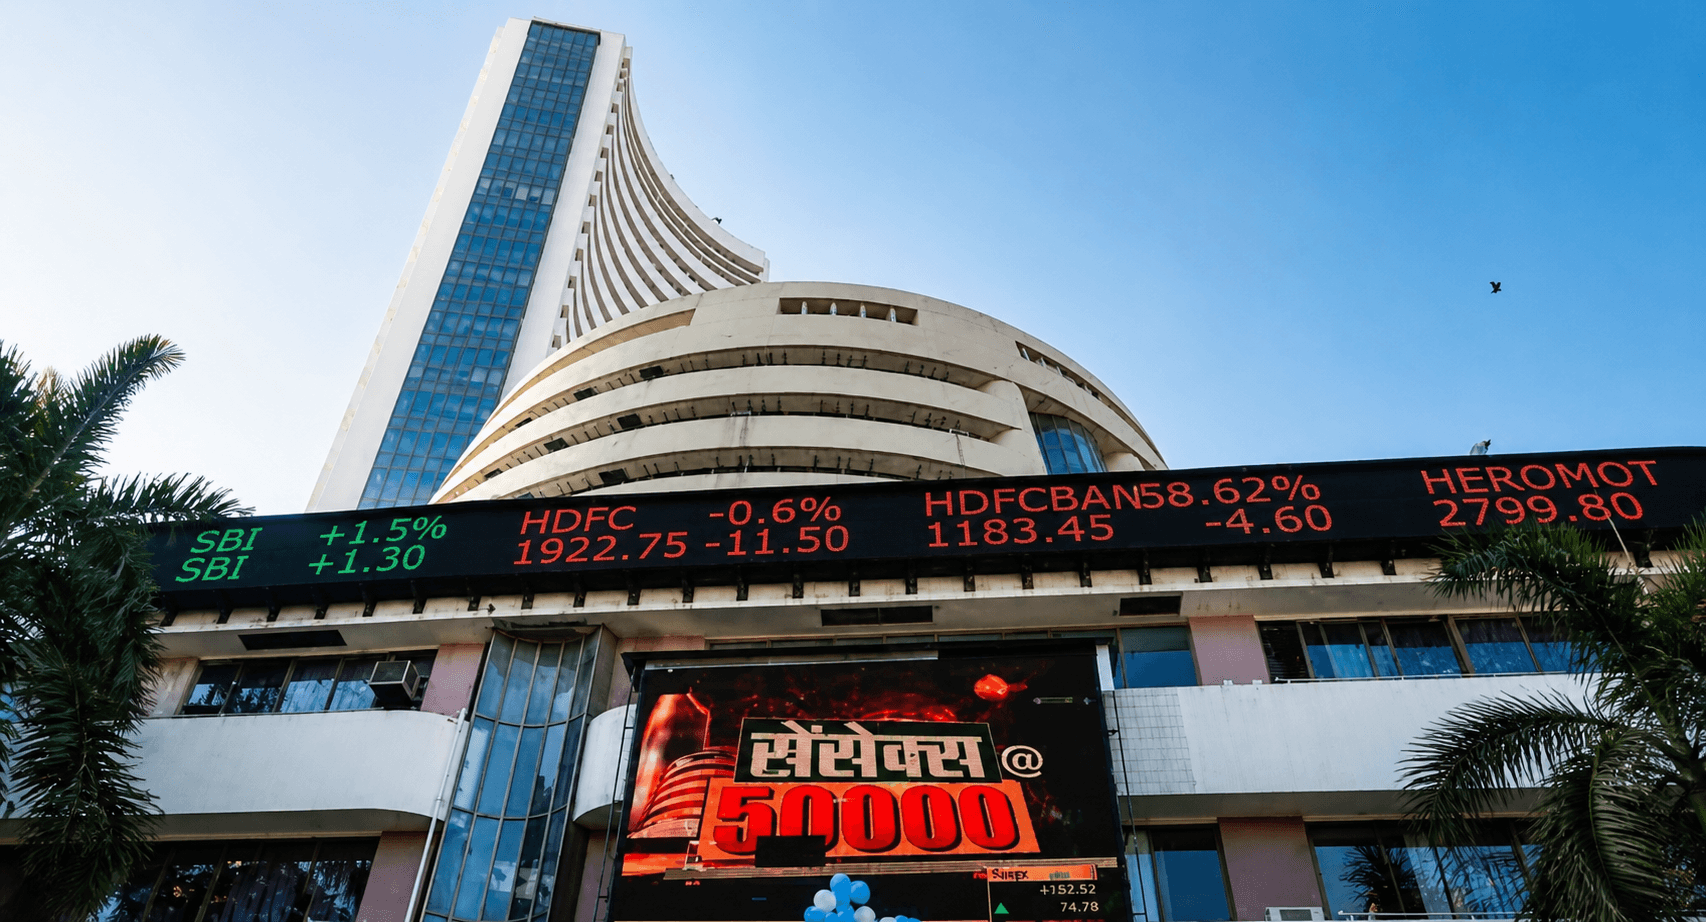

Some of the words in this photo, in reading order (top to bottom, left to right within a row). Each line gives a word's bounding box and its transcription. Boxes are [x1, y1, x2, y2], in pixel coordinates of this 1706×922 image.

[1420, 460, 1658, 494] HEROMOT
[520, 505, 637, 535] HDFC
[709, 496, 842, 526] -0.6%
[928, 514, 1114, 548] 1183.45
[1205, 504, 1332, 534] -4.60
[1433, 492, 1643, 527] 2799.80
[189, 526, 264, 554] SBI
[319, 515, 448, 546] +1.5%
[513, 531, 688, 565] 1922.75
[705, 525, 849, 556] -11.50
[174, 554, 250, 583] SBI
[308, 544, 426, 576] +1.30
[750, 720, 986, 778] सेंसेक्स
[1001, 744, 1044, 778] @
[713, 784, 1020, 855] 50000
[1040, 883, 1097, 895] +152.52
[1060, 901, 1100, 913] 74.78
